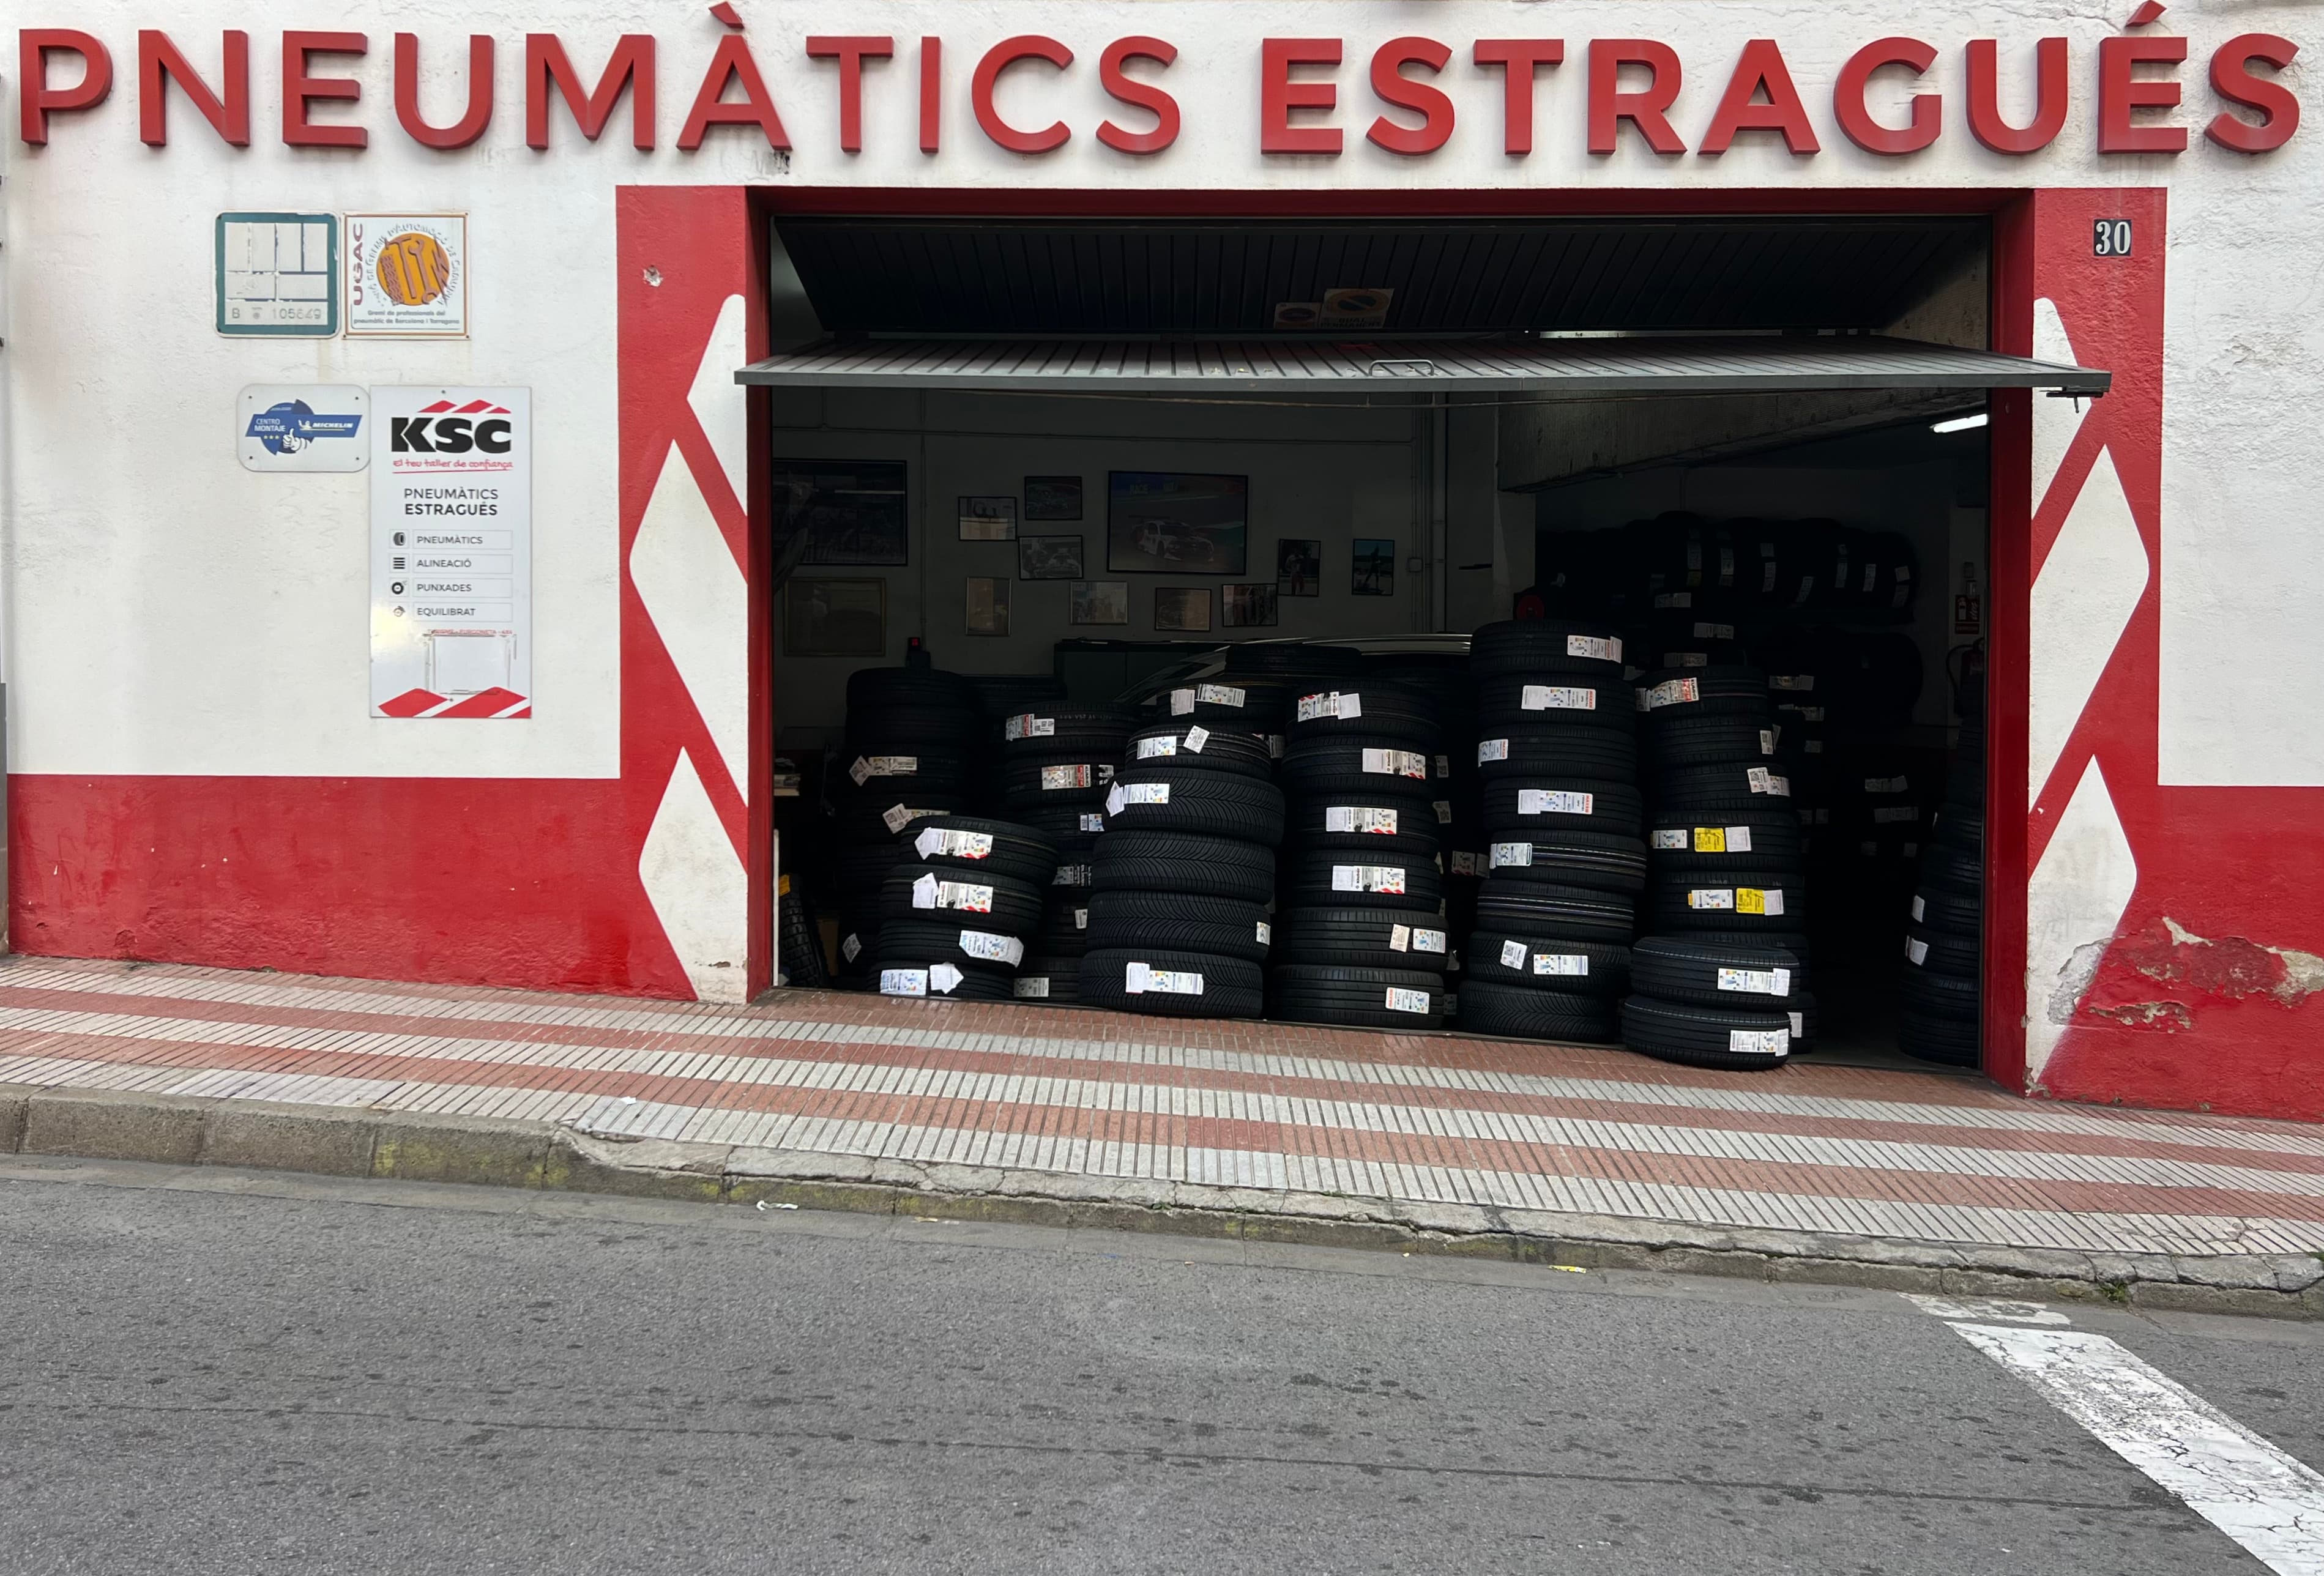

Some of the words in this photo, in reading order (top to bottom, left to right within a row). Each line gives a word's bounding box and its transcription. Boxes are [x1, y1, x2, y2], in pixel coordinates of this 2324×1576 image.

[19, 1, 1180, 156] PNEUMÀTICS
[1261, 0, 2301, 155] ESTRAGUÉS
[2096, 221, 2131, 255] 30
[353, 223, 363, 306] UGAC
[231, 308, 240, 319] B
[391, 417, 512, 454] KSC
[425, 459, 451, 467] taller
[469, 459, 513, 470] confiança
[404, 486, 499, 500] PNEUMÀTICS
[405, 502, 497, 516] ESTRAGUÉS
[417, 535, 483, 544] PNEUMÀTICS
[416, 559, 472, 568] ALINEACIÓ
[417, 608, 476, 617] EQUILIBRAT
